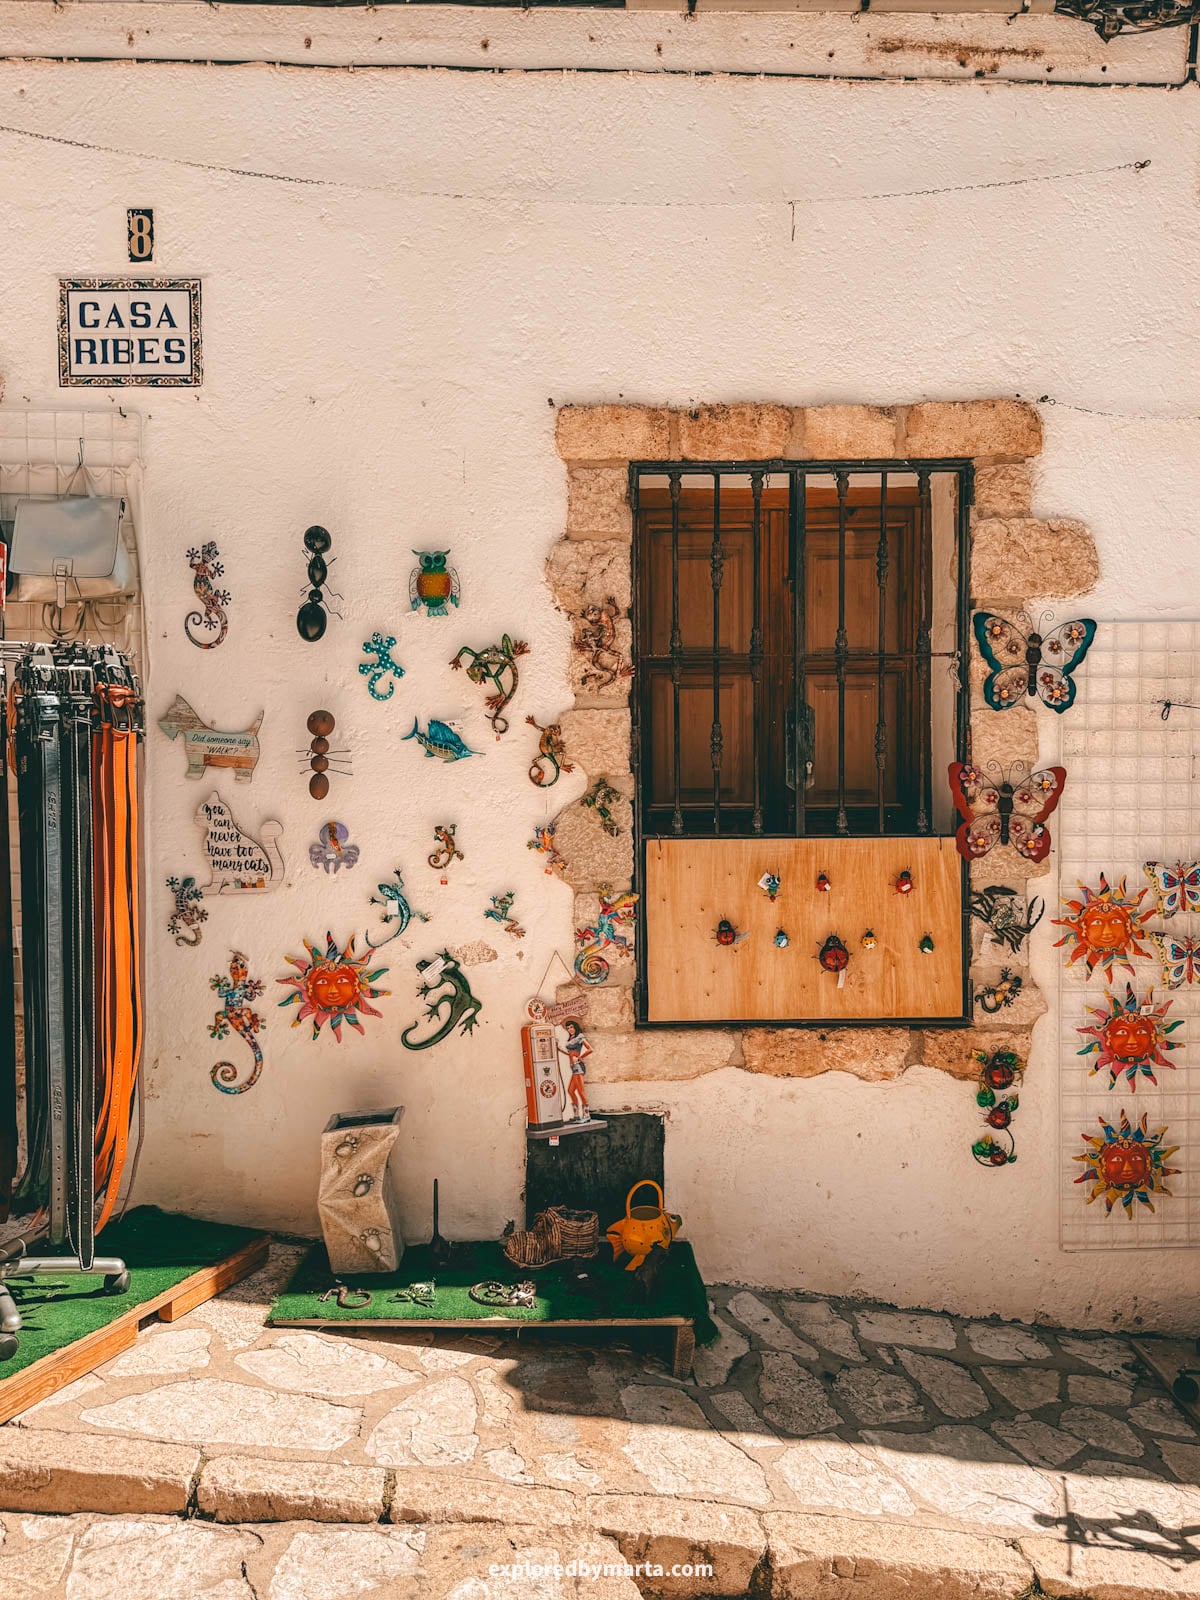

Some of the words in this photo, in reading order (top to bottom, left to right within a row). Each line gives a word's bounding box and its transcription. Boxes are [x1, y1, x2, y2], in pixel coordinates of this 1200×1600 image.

[130, 214, 151, 258] 8
[79, 301, 178, 329] CASA
[74, 338, 186, 365] RIBES
[192, 734, 206, 742] Did
[207, 736, 236, 744] someone
[238, 739, 251, 748] say
[202, 804, 226, 820] you
[214, 819, 231, 830] can
[210, 831, 241, 843] never
[207, 840, 232, 857] have
[234, 845, 258, 858] too
[213, 859, 243, 872] many
[244, 858, 270, 873] cats
